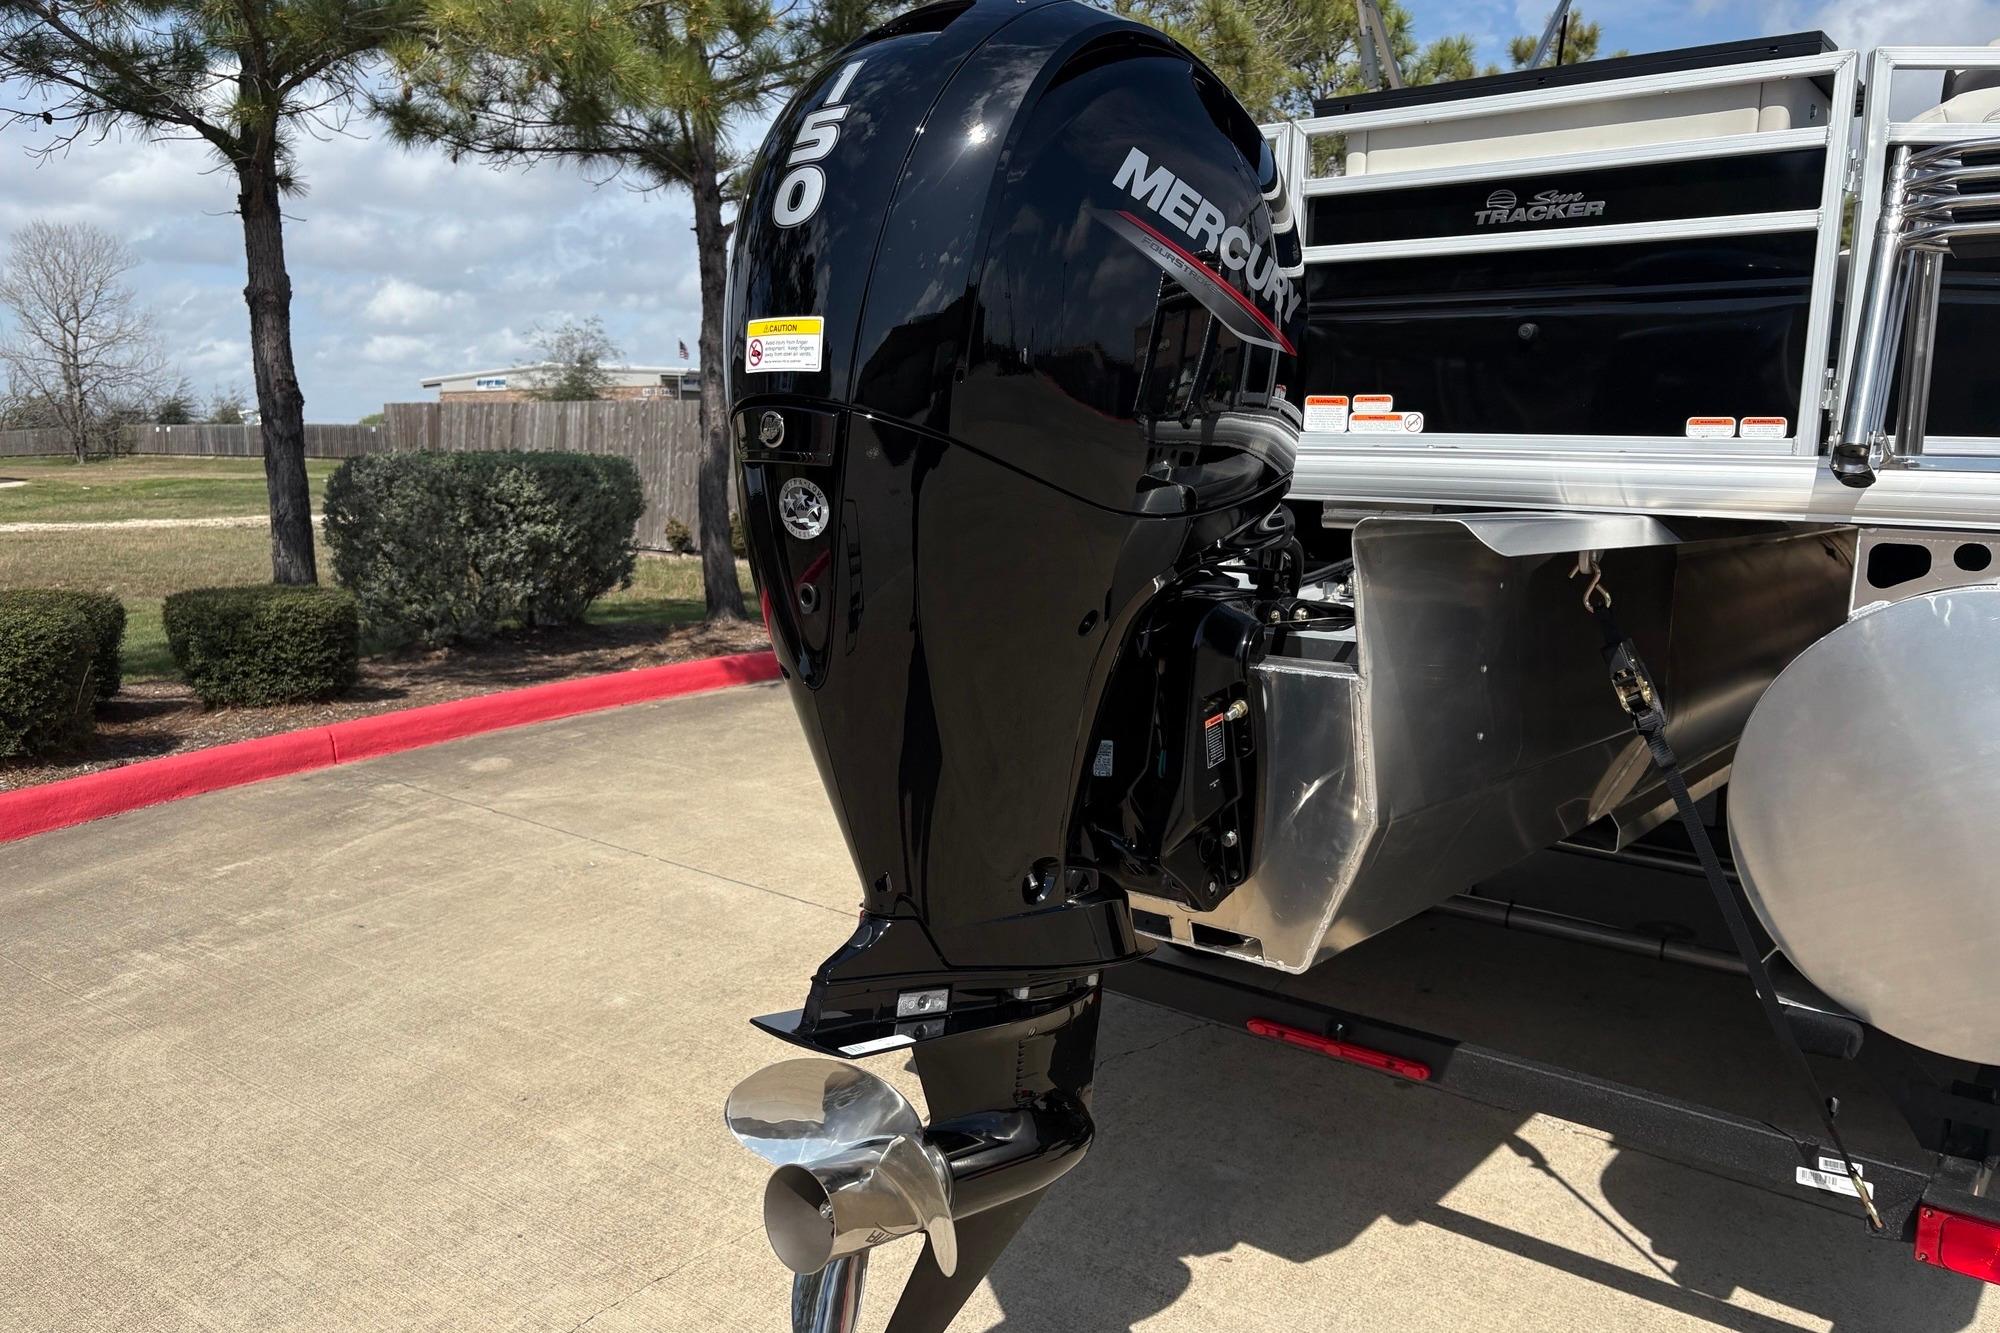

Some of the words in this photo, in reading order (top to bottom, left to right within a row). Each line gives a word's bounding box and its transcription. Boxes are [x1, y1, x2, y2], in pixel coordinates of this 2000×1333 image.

[772, 58, 868, 229] 150
[1112, 146, 1302, 324] MERCURY
[1474, 200, 1606, 226] TRACKER
[1141, 235, 1219, 297] FOURSTROKE
[769, 324, 798, 333] CAUTION
